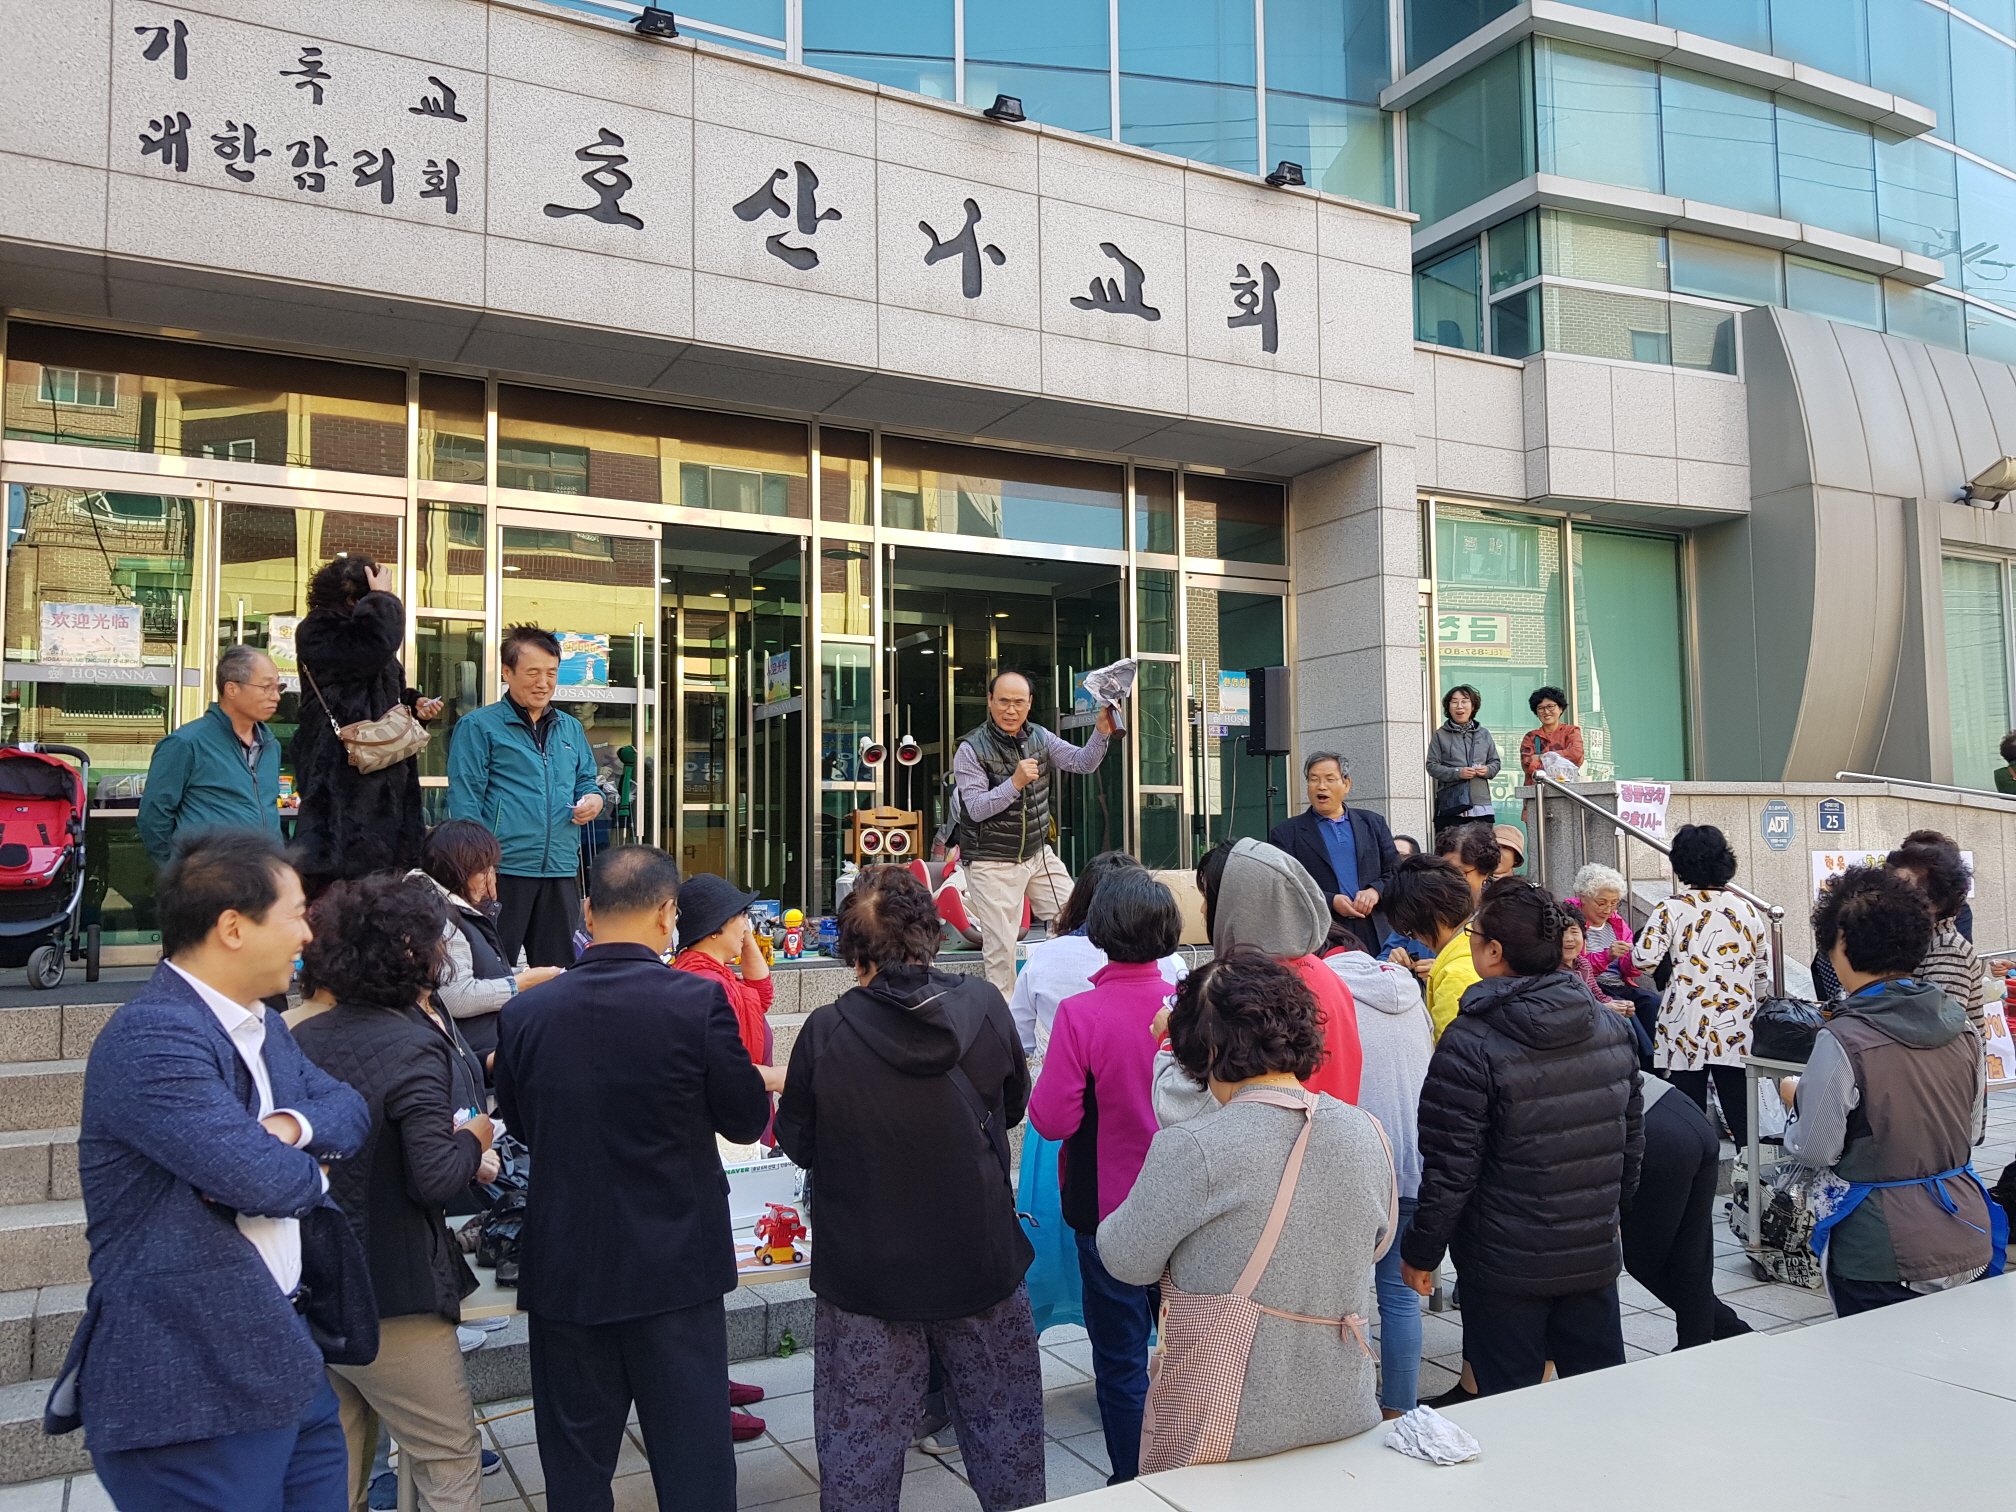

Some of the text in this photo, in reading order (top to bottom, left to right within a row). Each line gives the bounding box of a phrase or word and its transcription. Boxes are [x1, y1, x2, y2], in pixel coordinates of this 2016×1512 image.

[139, 111, 461, 214] 대한감리회
[543, 128, 1280, 354] 호산나교회
[51, 611, 130, 630] 欢迎光临
[71, 668, 158, 681] HOSANNA
[1767, 816, 1789, 833] ADT
[1826, 815, 1839, 829] 25
